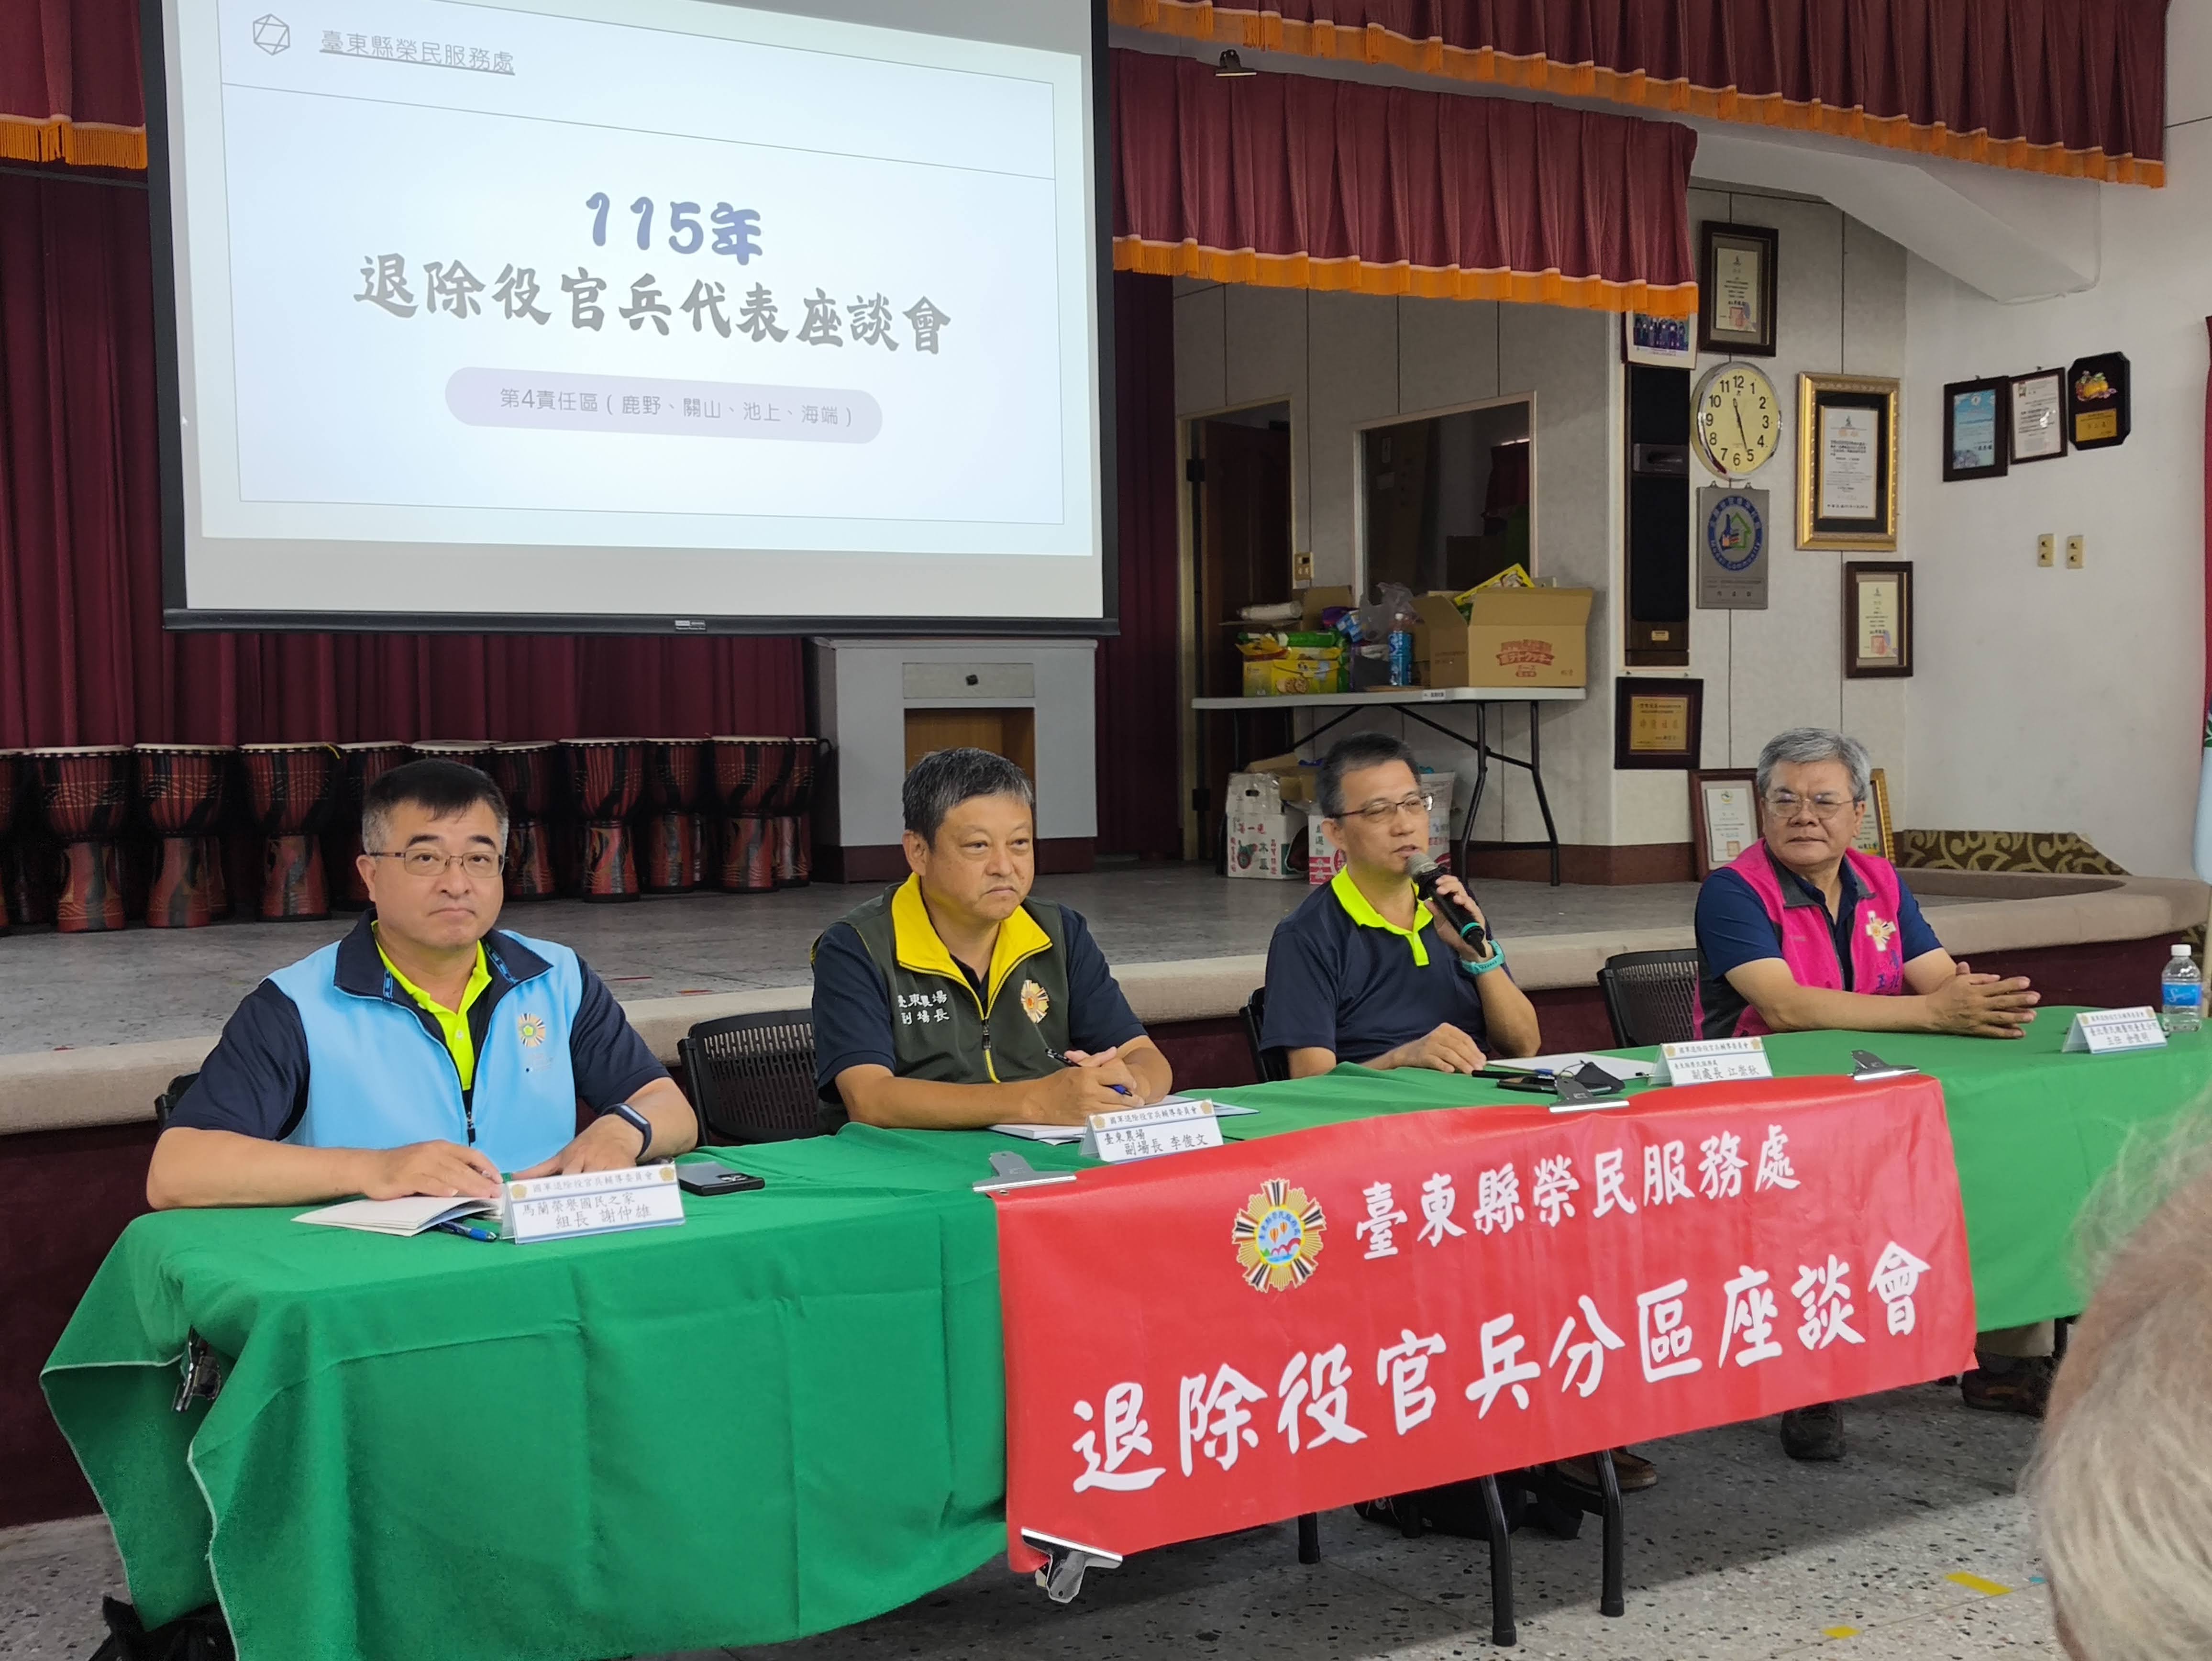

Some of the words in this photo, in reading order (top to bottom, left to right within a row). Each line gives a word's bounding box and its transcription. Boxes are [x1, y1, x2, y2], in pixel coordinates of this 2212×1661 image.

[321, 29, 515, 73] 臺東縣榮民服務處
[586, 191, 763, 266] 115年
[353, 252, 951, 355] 退除役官兵代表座談會
[1720, 380, 1730, 393] 11
[1733, 376, 1745, 389] 12
[1750, 382, 1756, 394] 1
[1709, 395, 1721, 408] 10
[1759, 397, 1766, 409] 2
[1706, 413, 1714, 426] 9
[1762, 415, 1770, 429] 3
[1710, 432, 1717, 445] 8
[1757, 435, 1764, 447] 4
[1721, 448, 1728, 461] 7
[1733, 453, 1740, 466] 6
[1747, 449, 1754, 462] 5
[1109, 1106, 1197, 1125] 國軍退除役官兵輔導委員會
[1104, 1129, 1145, 1145] 臺東農場
[1125, 1138, 1164, 1156] 副場長
[1170, 1133, 1208, 1150] 李俊文
[532, 1171, 653, 1193] 國軍退除役官兵輔導委員會
[1357, 1124, 1802, 1261] 臺東縣榮民服務處
[522, 1192, 636, 1217] 馬蘭榮譽國民之家
[555, 1212, 590, 1229] 組長
[598, 1204, 652, 1224] 謝仲雄
[1072, 1240, 1931, 1493] 退除役官兵分區座談會
